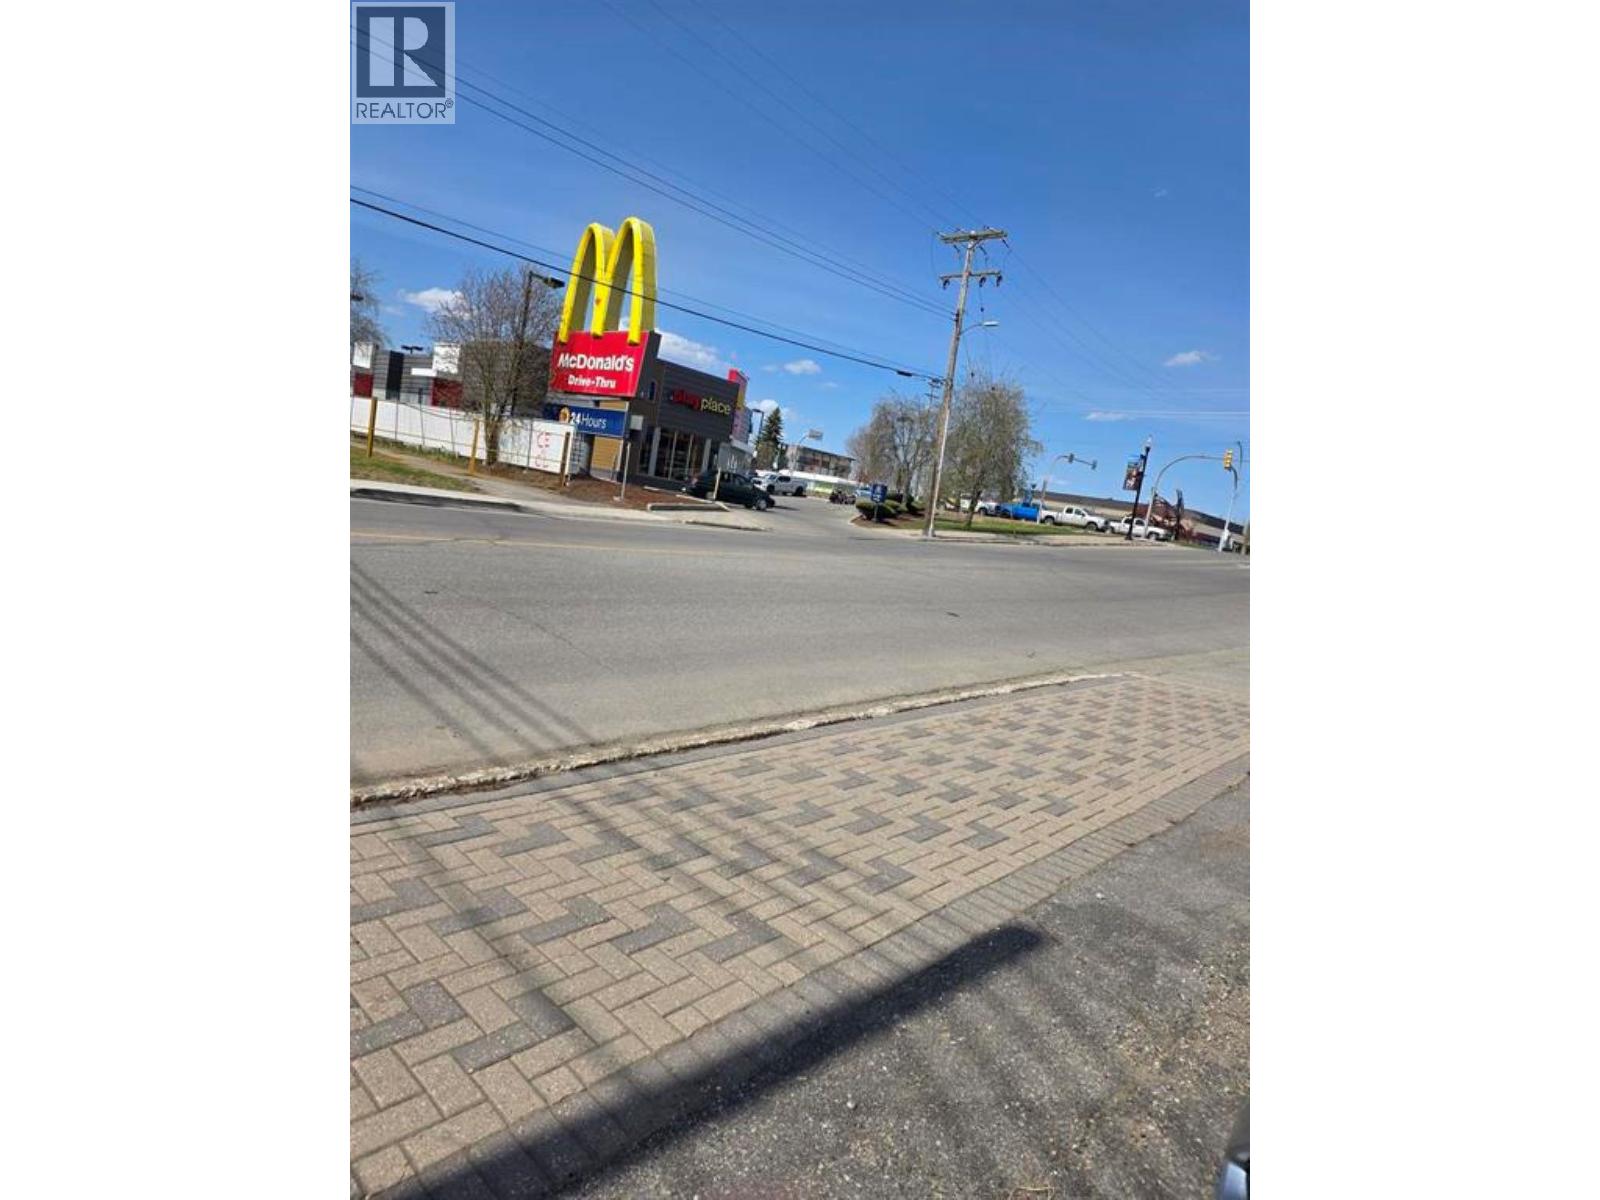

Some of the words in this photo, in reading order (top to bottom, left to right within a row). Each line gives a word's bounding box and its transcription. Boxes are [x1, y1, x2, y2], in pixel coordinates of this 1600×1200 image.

[557, 352, 635, 373] McDonald's
[567, 374, 617, 389] Drive-Thru
[700, 396, 732, 415] place
